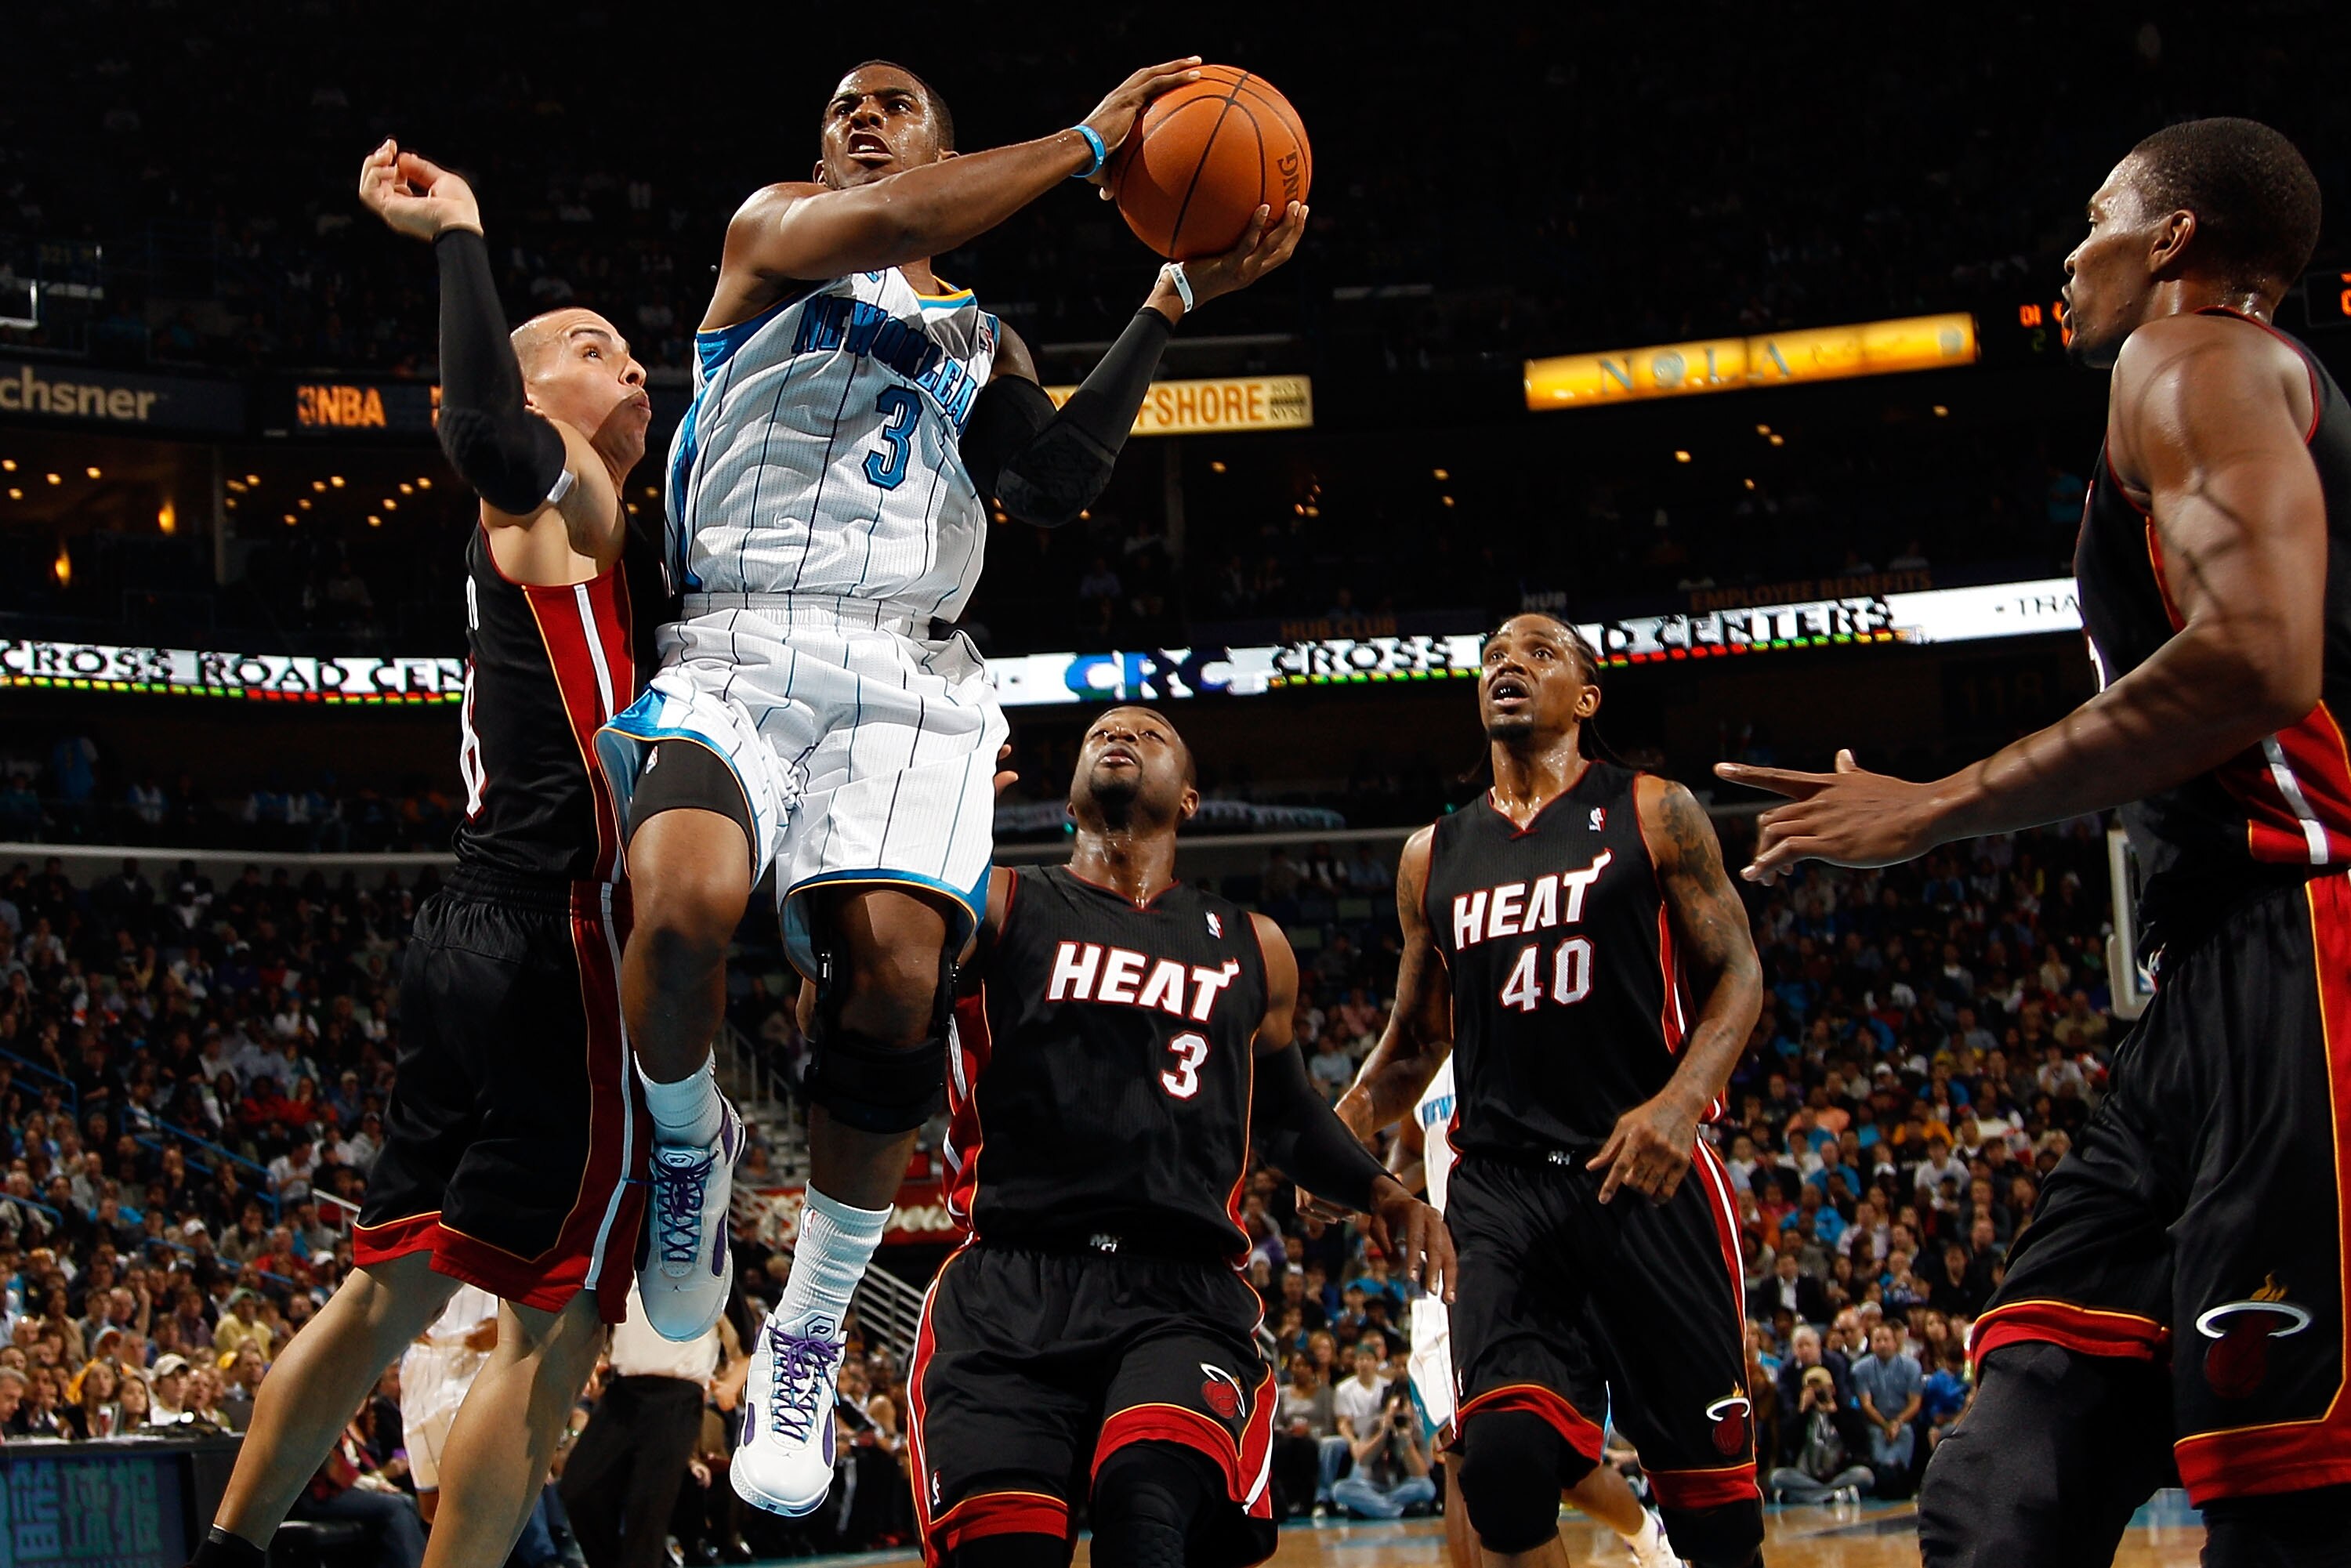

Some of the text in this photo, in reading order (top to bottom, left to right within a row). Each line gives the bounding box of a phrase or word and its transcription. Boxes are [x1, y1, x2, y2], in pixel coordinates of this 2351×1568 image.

[0, 365, 157, 422] chsner
[791, 294, 980, 436] NEW ORLEA
[317, 385, 387, 428] NBA
[862, 384, 924, 491] 3
[1270, 636, 1452, 680] CROSS
[1655, 595, 1895, 650] CENTERS
[0, 646, 172, 683] CROSS
[196, 650, 350, 693] ROAD
[1453, 847, 1616, 951] HEAT
[1045, 940, 1241, 1024] HEAT
[1499, 935, 1595, 1013] 40
[1160, 1030, 1211, 1101] 3
